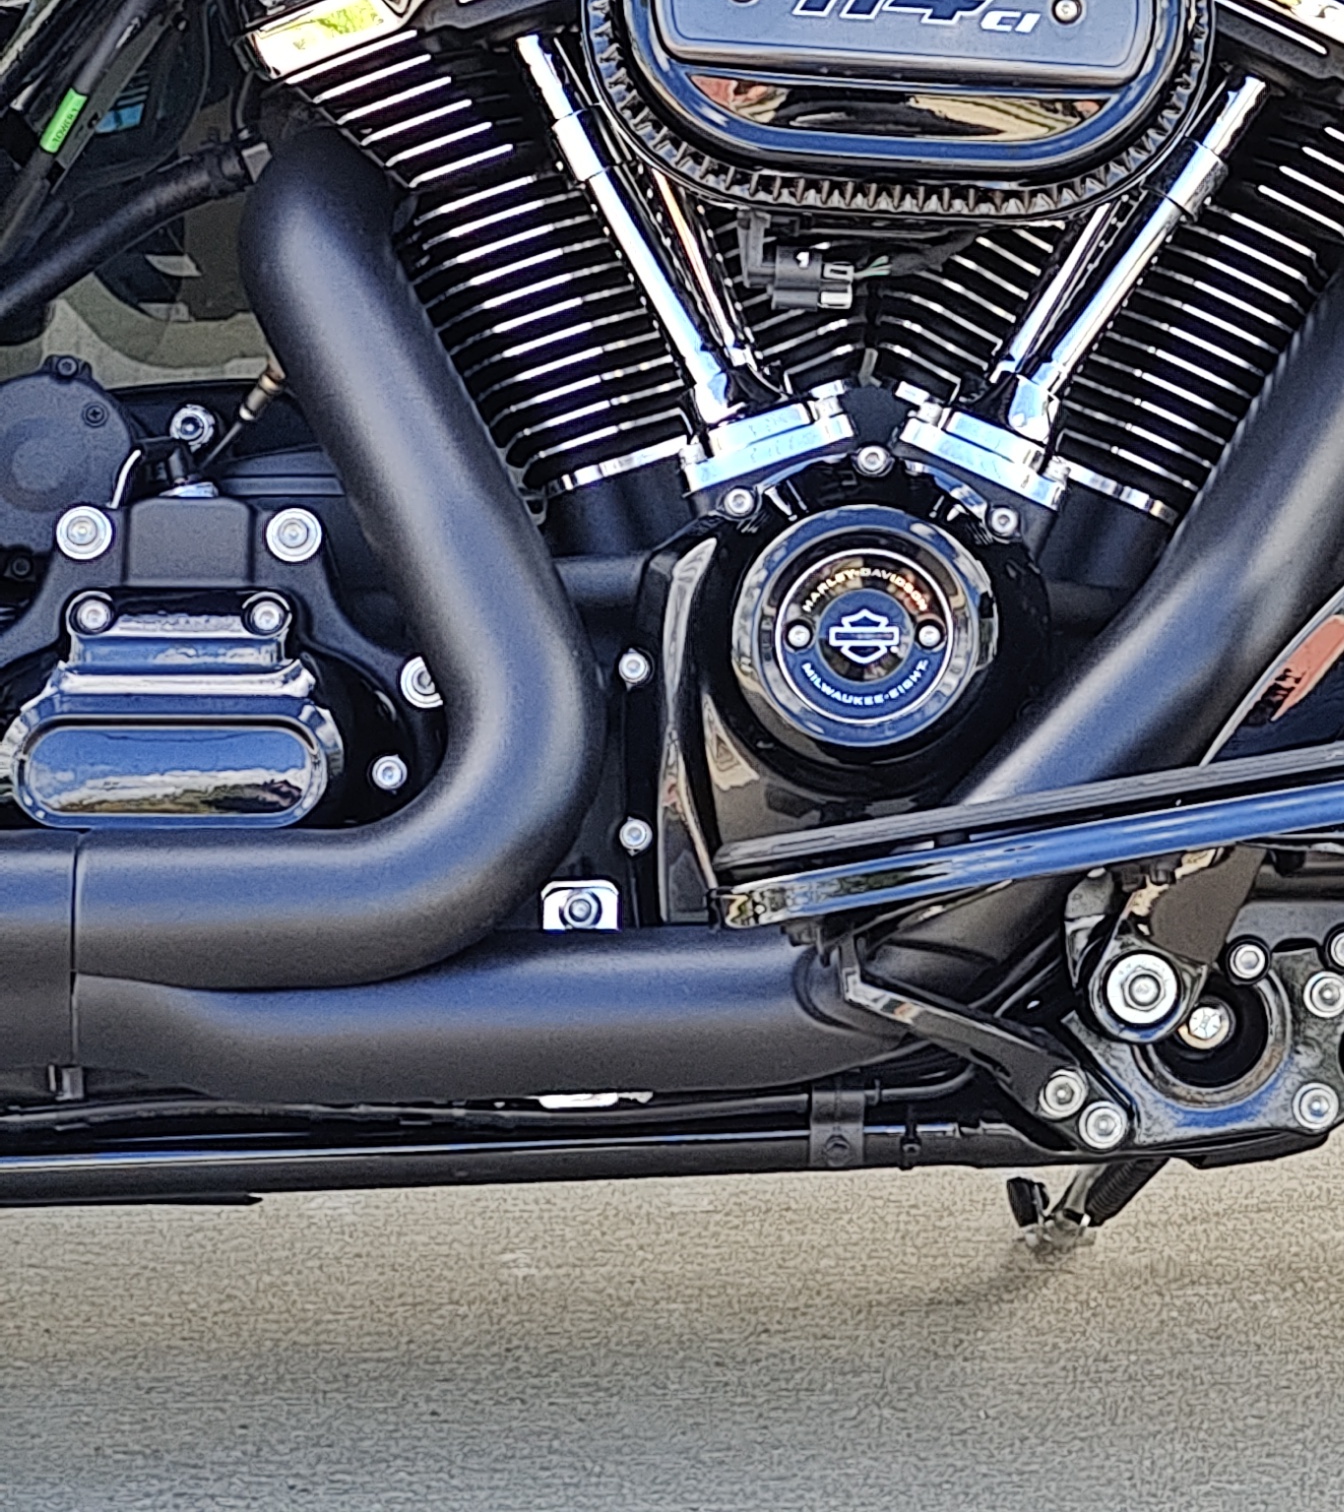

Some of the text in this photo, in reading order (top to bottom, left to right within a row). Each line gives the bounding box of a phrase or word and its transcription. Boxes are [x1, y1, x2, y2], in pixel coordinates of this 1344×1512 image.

[980, 10, 1041, 33] CI
[802, 567, 929, 613] HARLEY-DAVIDSON
[802, 659, 929, 706] MILWAUKEE-EIGHT
